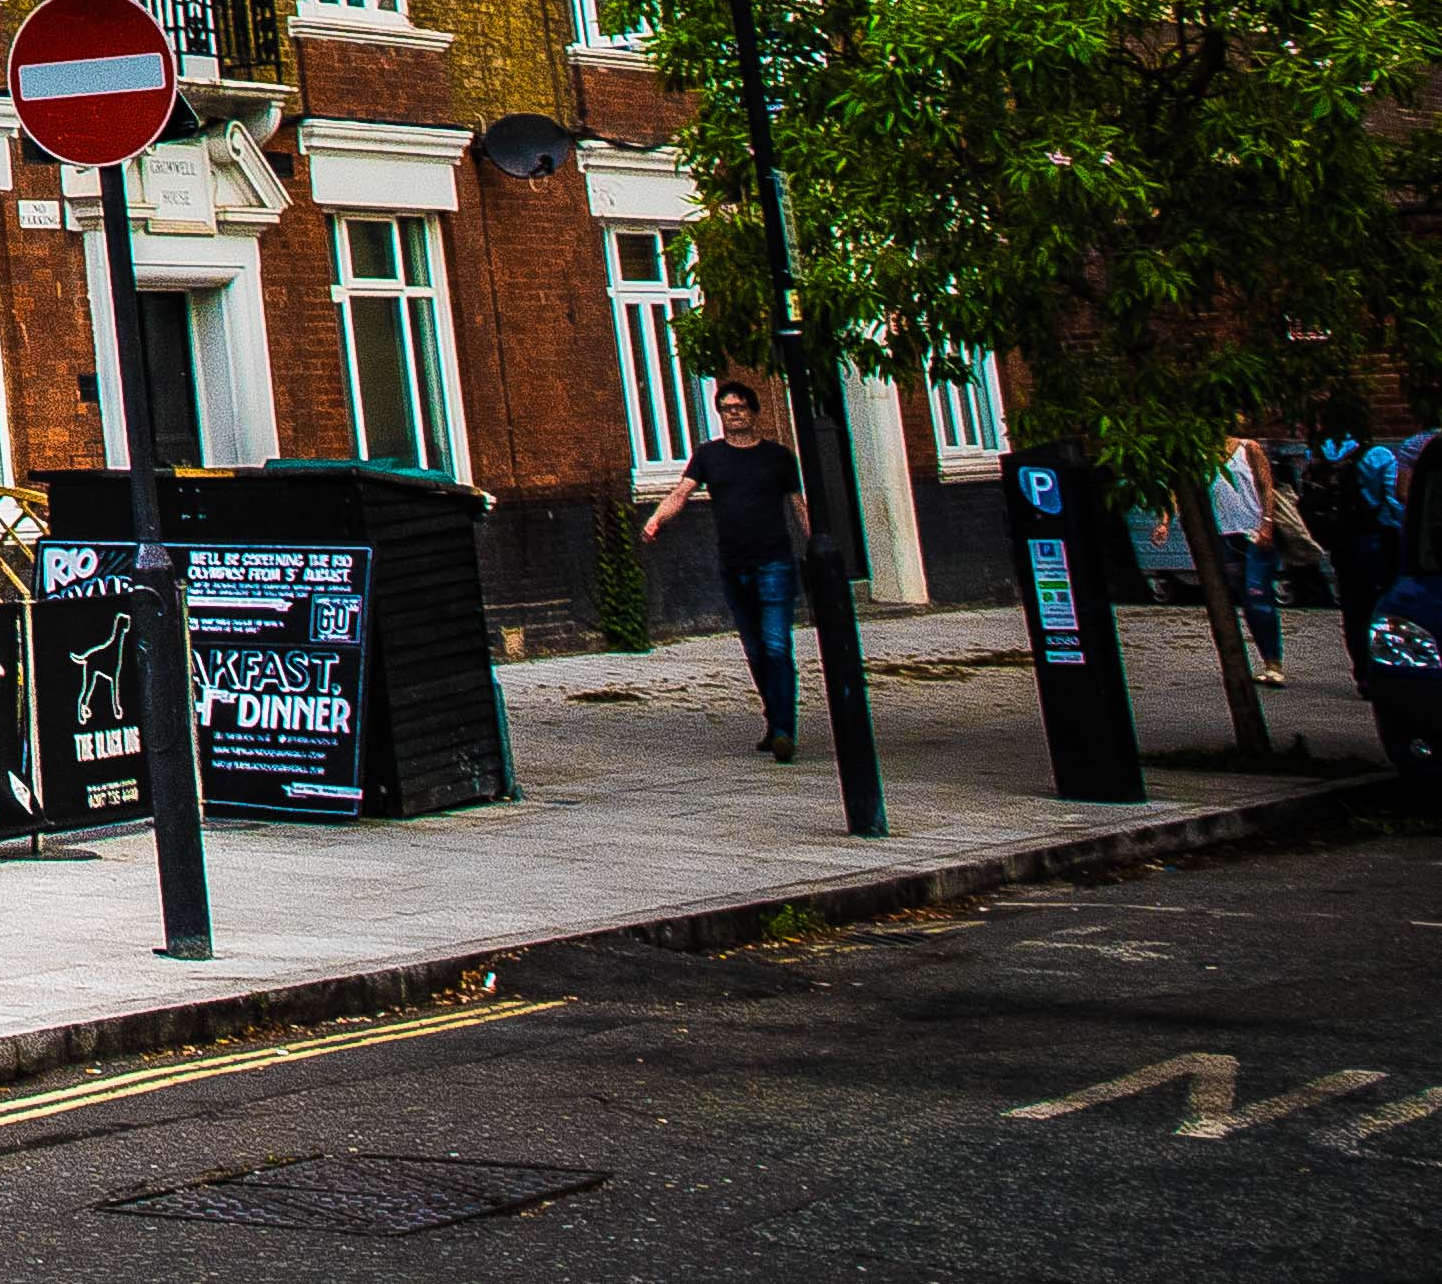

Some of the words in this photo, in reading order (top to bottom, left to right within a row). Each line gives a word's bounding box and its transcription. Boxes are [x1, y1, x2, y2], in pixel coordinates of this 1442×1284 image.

[1028, 472, 1053, 506] P
[44, 548, 98, 593] RIO
[237, 693, 351, 733] DINNER
[76, 734, 94, 762] THE
[95, 731, 123, 759] BLACK
